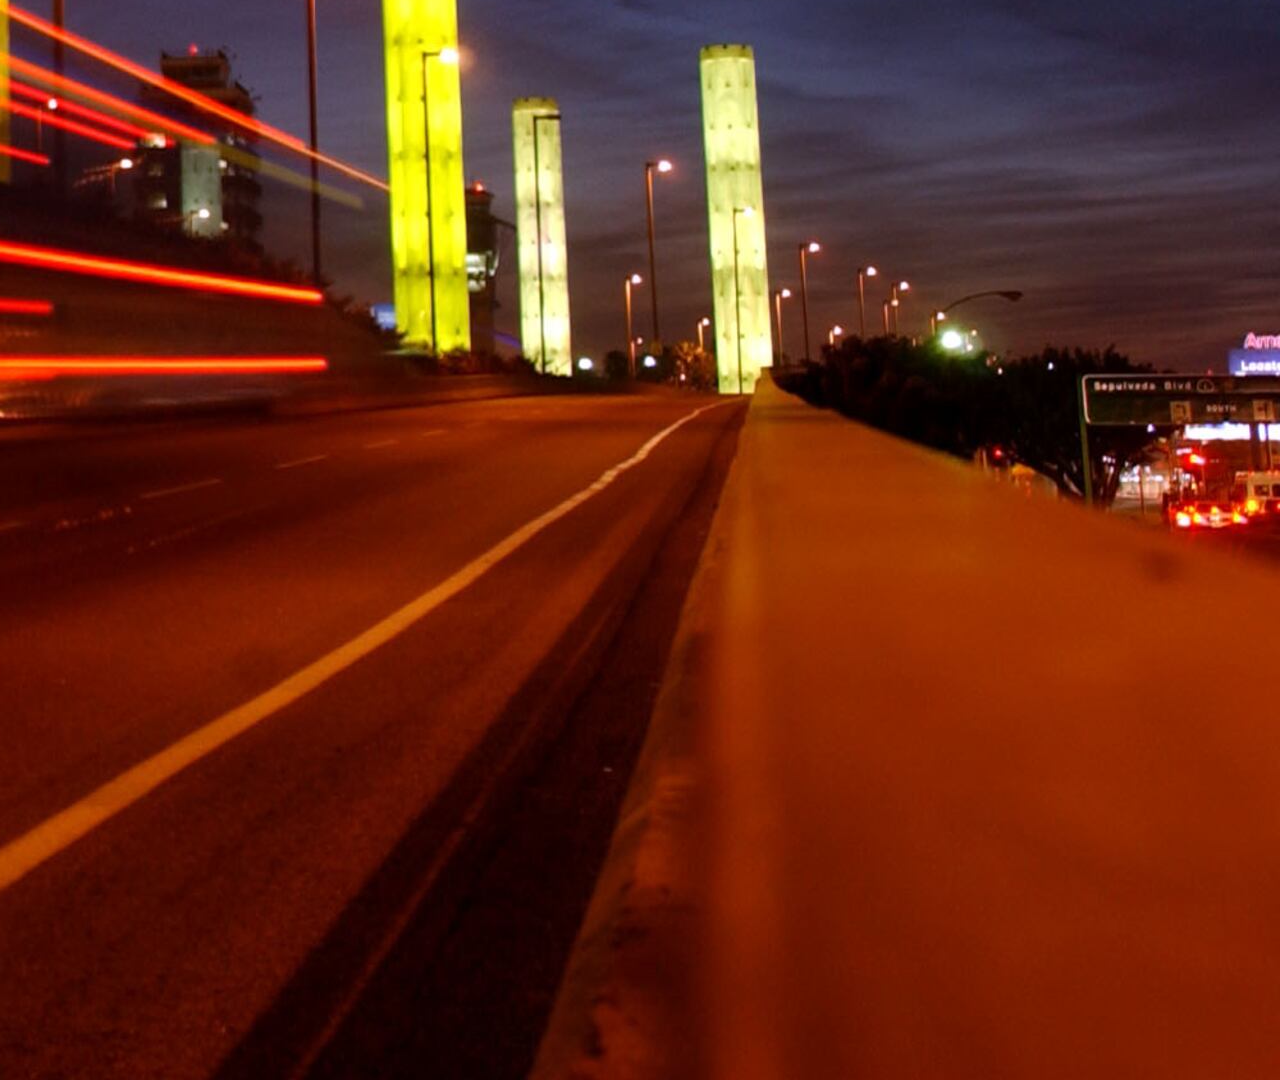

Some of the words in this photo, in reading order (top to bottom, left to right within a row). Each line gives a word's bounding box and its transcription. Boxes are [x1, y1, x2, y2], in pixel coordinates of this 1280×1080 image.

[1094, 381, 1156, 392] Sepulveda
[1164, 381, 1192, 391] Blvd
[1206, 404, 1237, 413] SOUTH
